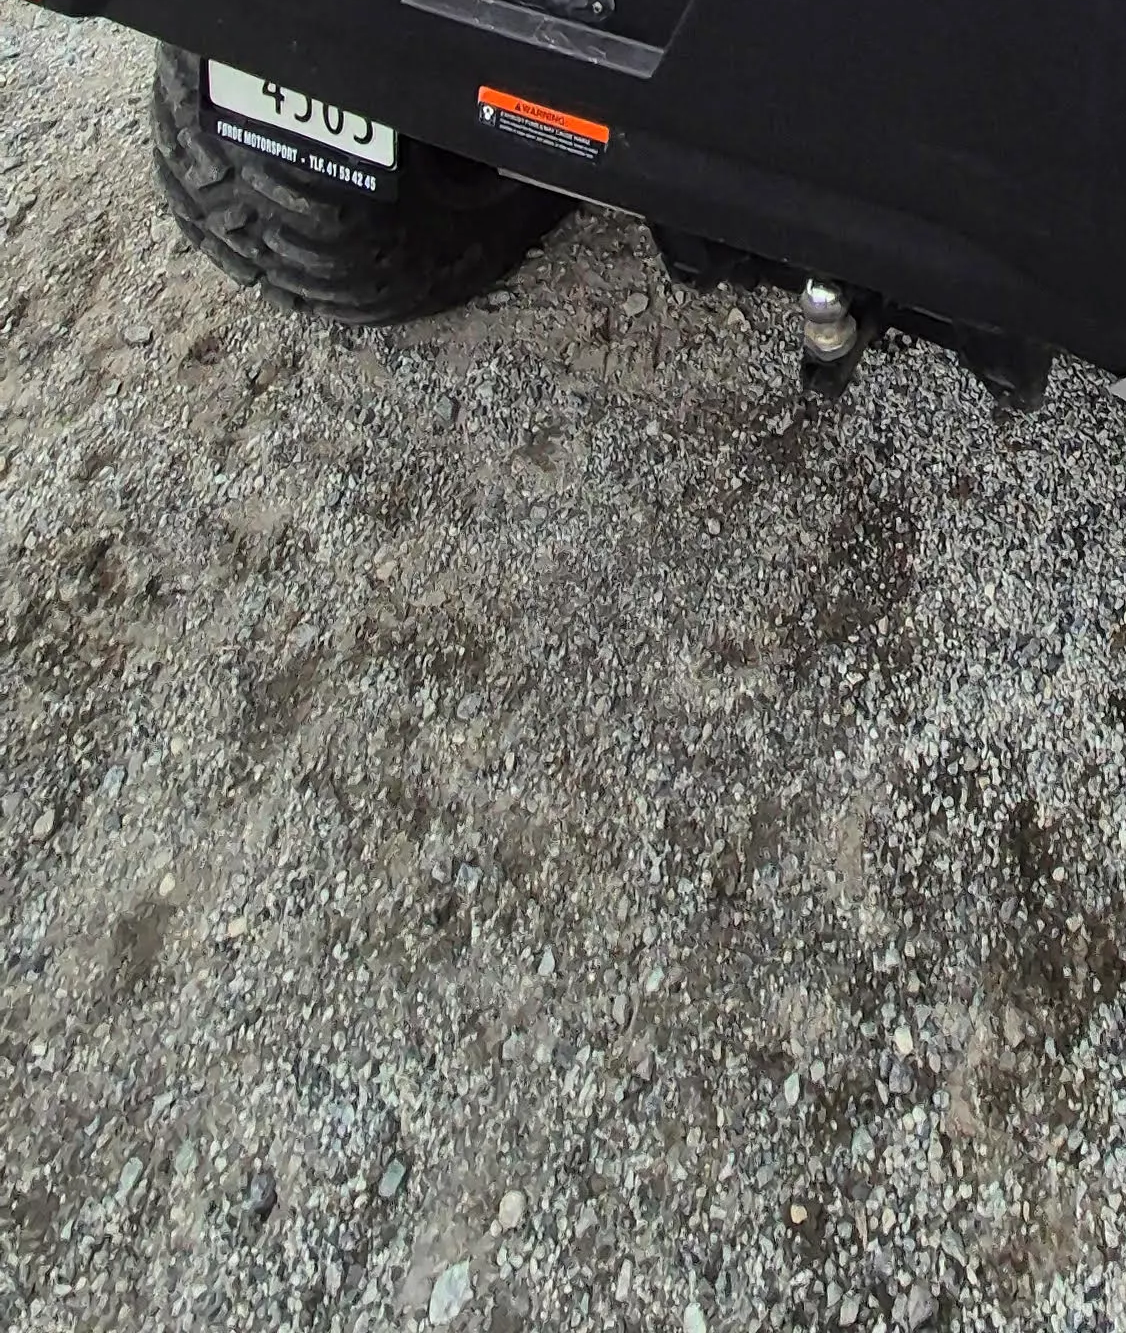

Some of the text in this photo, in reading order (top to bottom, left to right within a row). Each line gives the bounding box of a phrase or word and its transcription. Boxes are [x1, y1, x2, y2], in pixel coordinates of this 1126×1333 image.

[243, 130, 298, 163] MOTORSPORT
[326, 161, 337, 178] 41
[351, 170, 364, 187] 42
